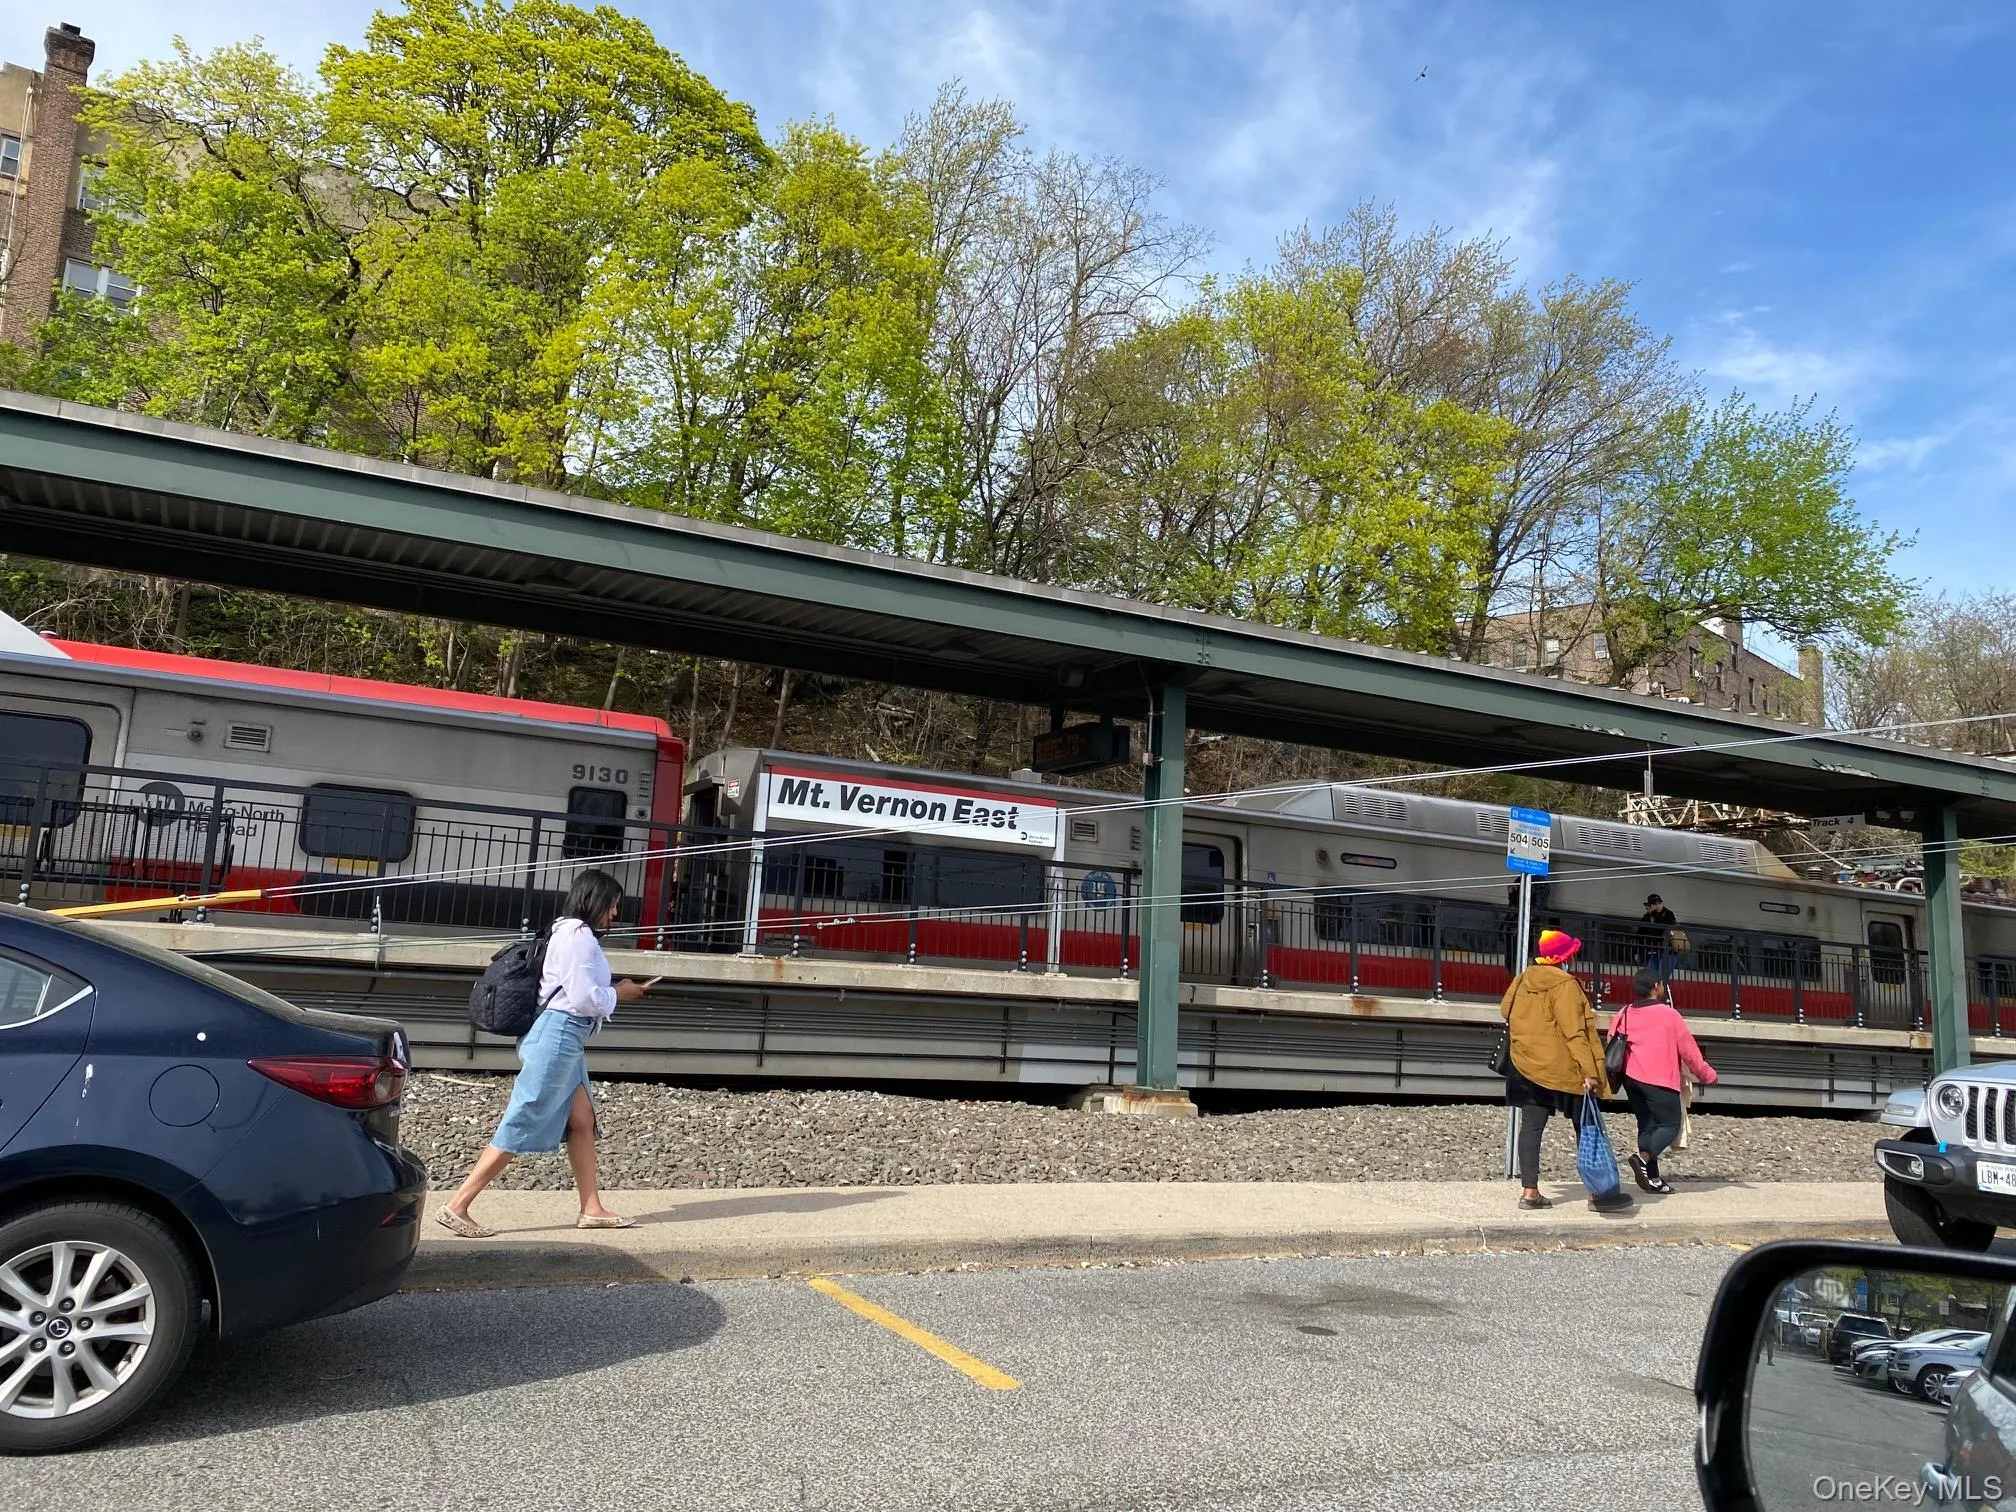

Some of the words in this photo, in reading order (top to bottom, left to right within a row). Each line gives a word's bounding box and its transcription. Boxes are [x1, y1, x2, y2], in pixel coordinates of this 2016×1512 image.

[572, 764, 628, 785] 9130
[187, 800, 285, 821] Mero-North
[777, 778, 830, 809] Mt.
[840, 784, 947, 822] Vernon
[952, 798, 1019, 830] East
[1812, 818, 1840, 827] Track
[1847, 817, 1854, 825] 4
[1510, 833, 1528, 845] 504
[1531, 837, 1549, 849] 505
